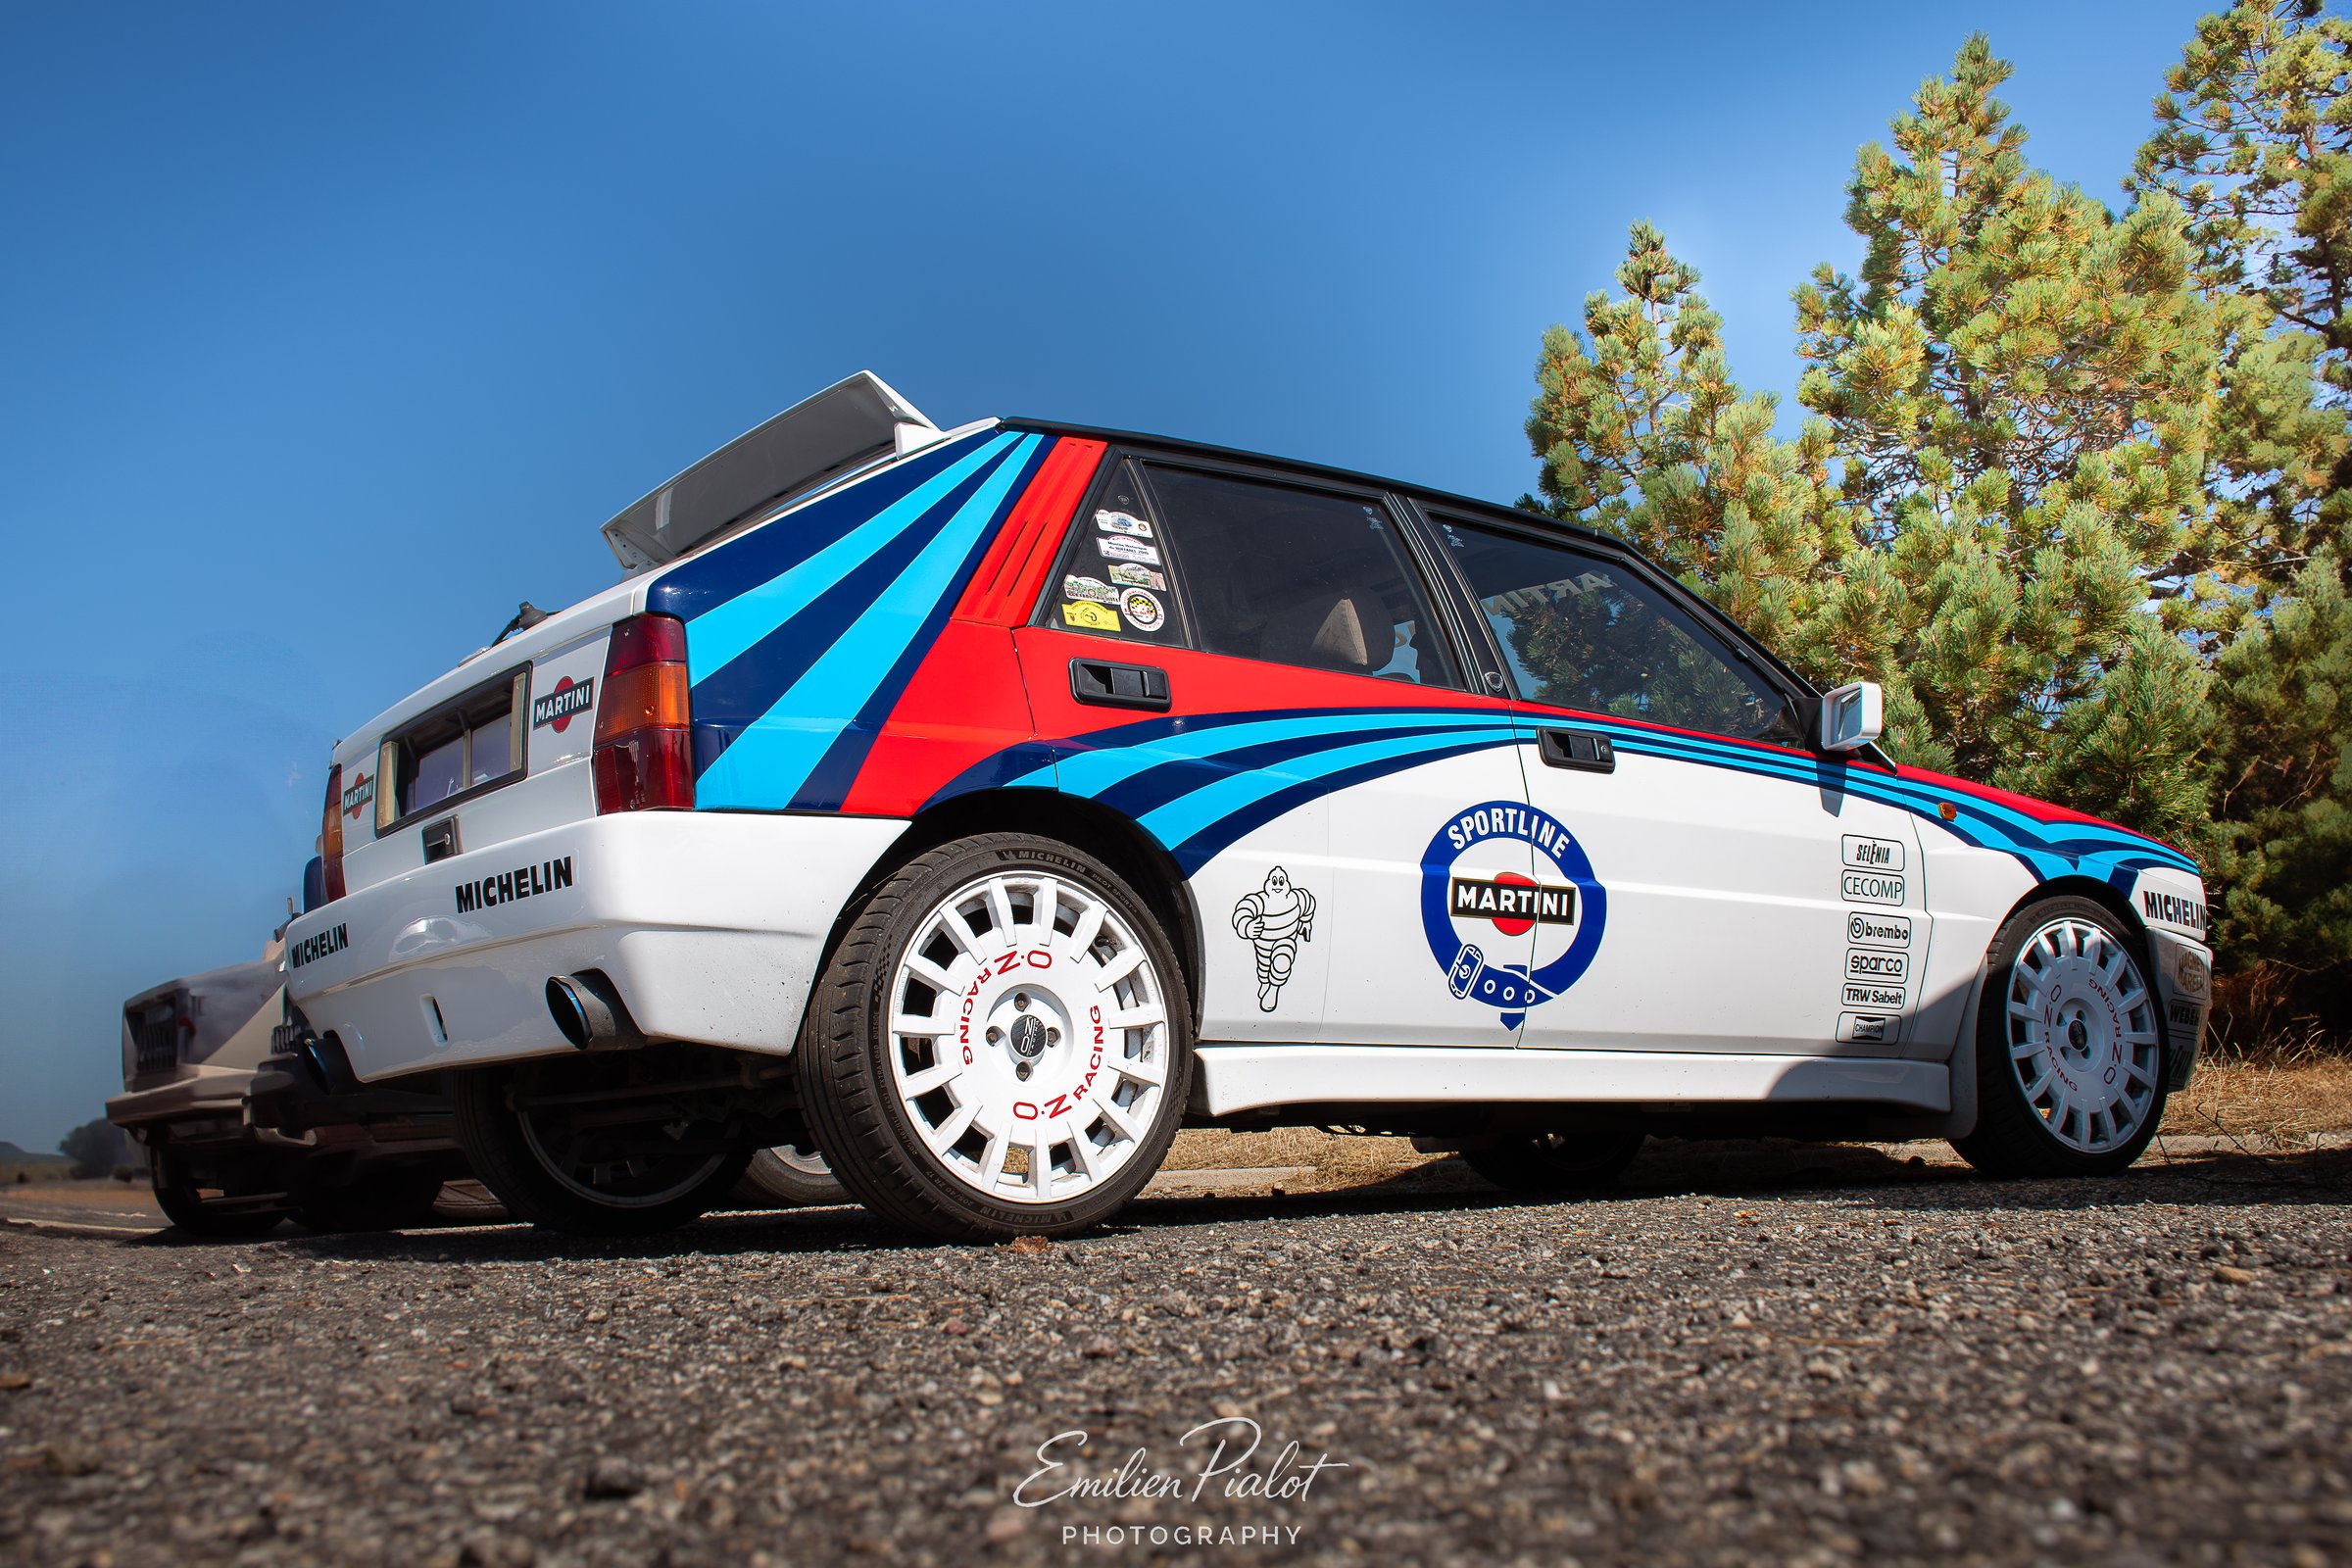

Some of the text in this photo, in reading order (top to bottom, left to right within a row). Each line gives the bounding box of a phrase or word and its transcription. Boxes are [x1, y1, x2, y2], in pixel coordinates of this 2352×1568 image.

[535, 684, 590, 722] MARTINI
[344, 780, 373, 811] MARTINI
[1448, 808, 1570, 858] SPORTLINE
[1019, 851, 1087, 873] MICHELIN
[455, 856, 573, 913] MICHELIN
[1092, 872, 1134, 909] PILOT SPORT
[1457, 885, 1568, 916] MARTINI
[1843, 876, 1902, 899] CECOMP
[2143, 890, 2206, 931] MICHELIN
[292, 922, 349, 968] MICHELIN
[1865, 922, 1908, 940] brembo
[1850, 955, 1902, 974] sparco
[1845, 988, 1902, 1004] TRW Sabelt
[2088, 979, 2122, 1038] RACING
[959, 967, 992, 1065] RACING
[1855, 1023, 1883, 1033] CHAMPION
[1072, 1004, 1104, 1101] RACING
[2044, 1031, 2078, 1092] RACING
[980, 1206, 1053, 1224] MICHELIN
